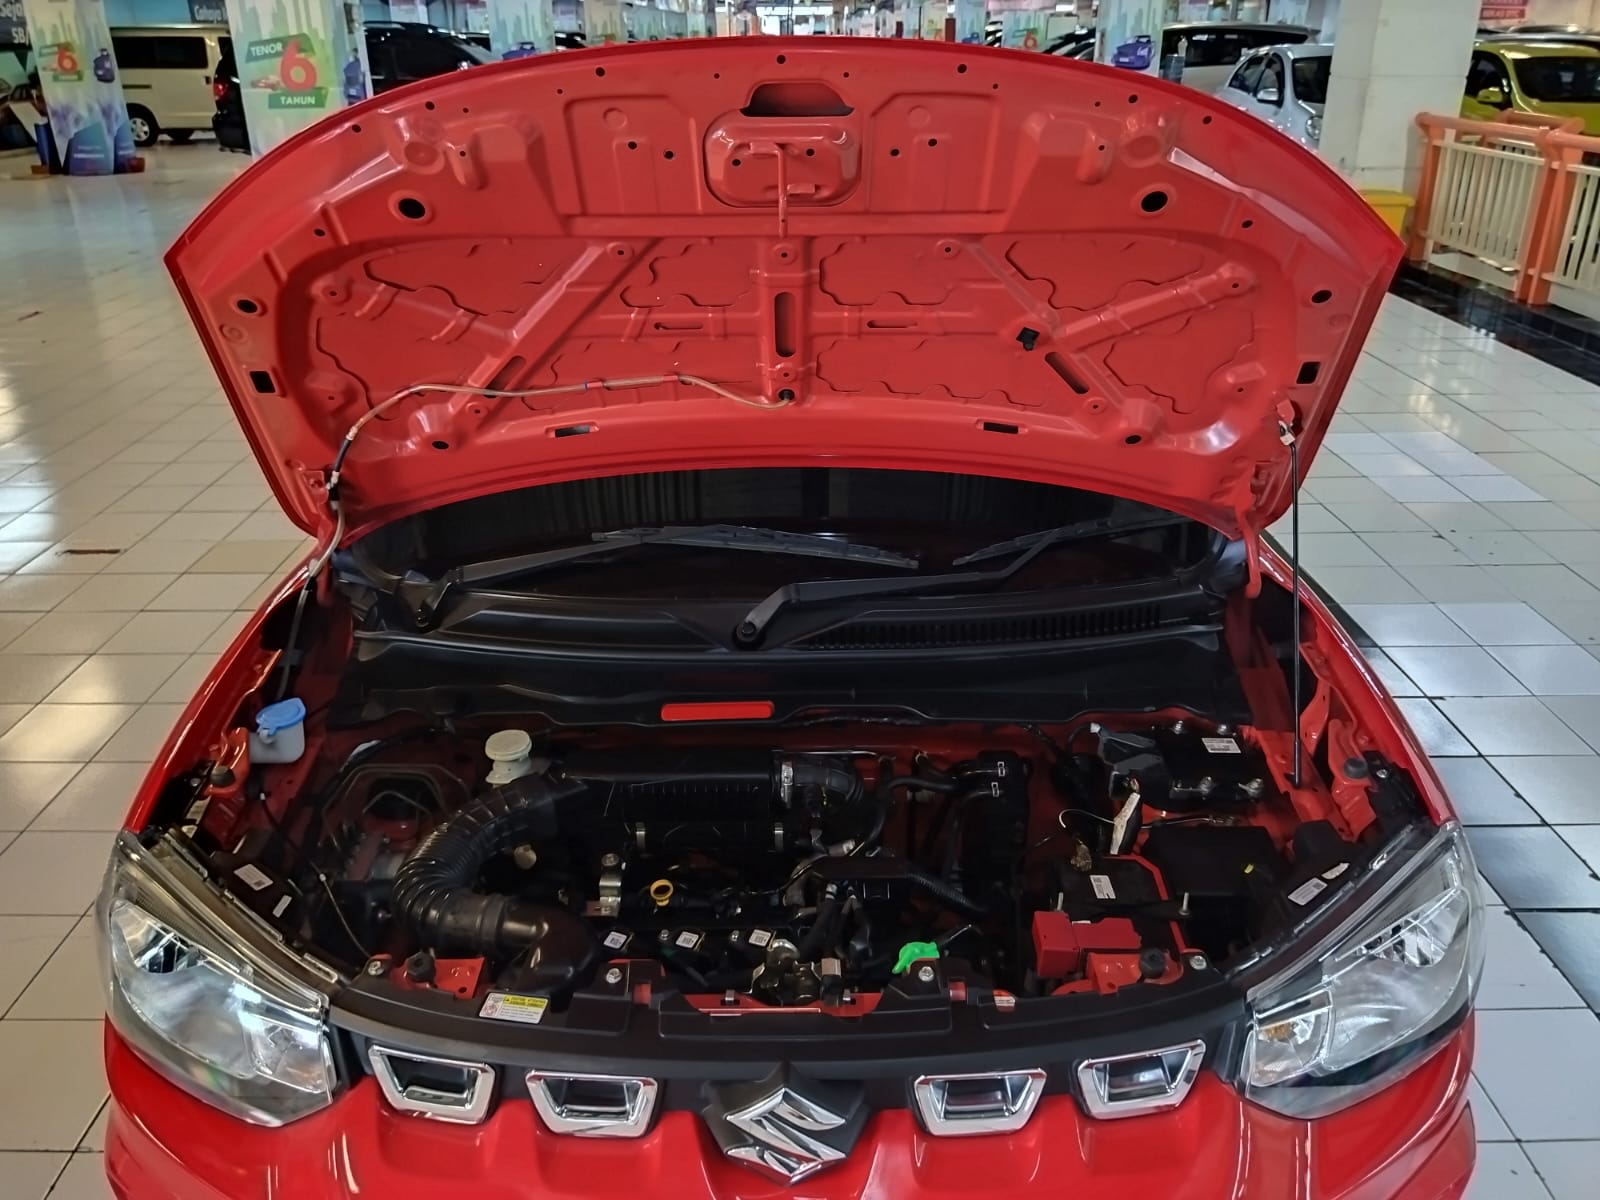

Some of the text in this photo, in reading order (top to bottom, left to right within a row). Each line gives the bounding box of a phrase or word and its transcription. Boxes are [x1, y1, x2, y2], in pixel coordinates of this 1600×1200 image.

[250, 42, 284, 57] TENOR
[280, 40, 317, 92] 6
[280, 96, 316, 105] TAHUN
